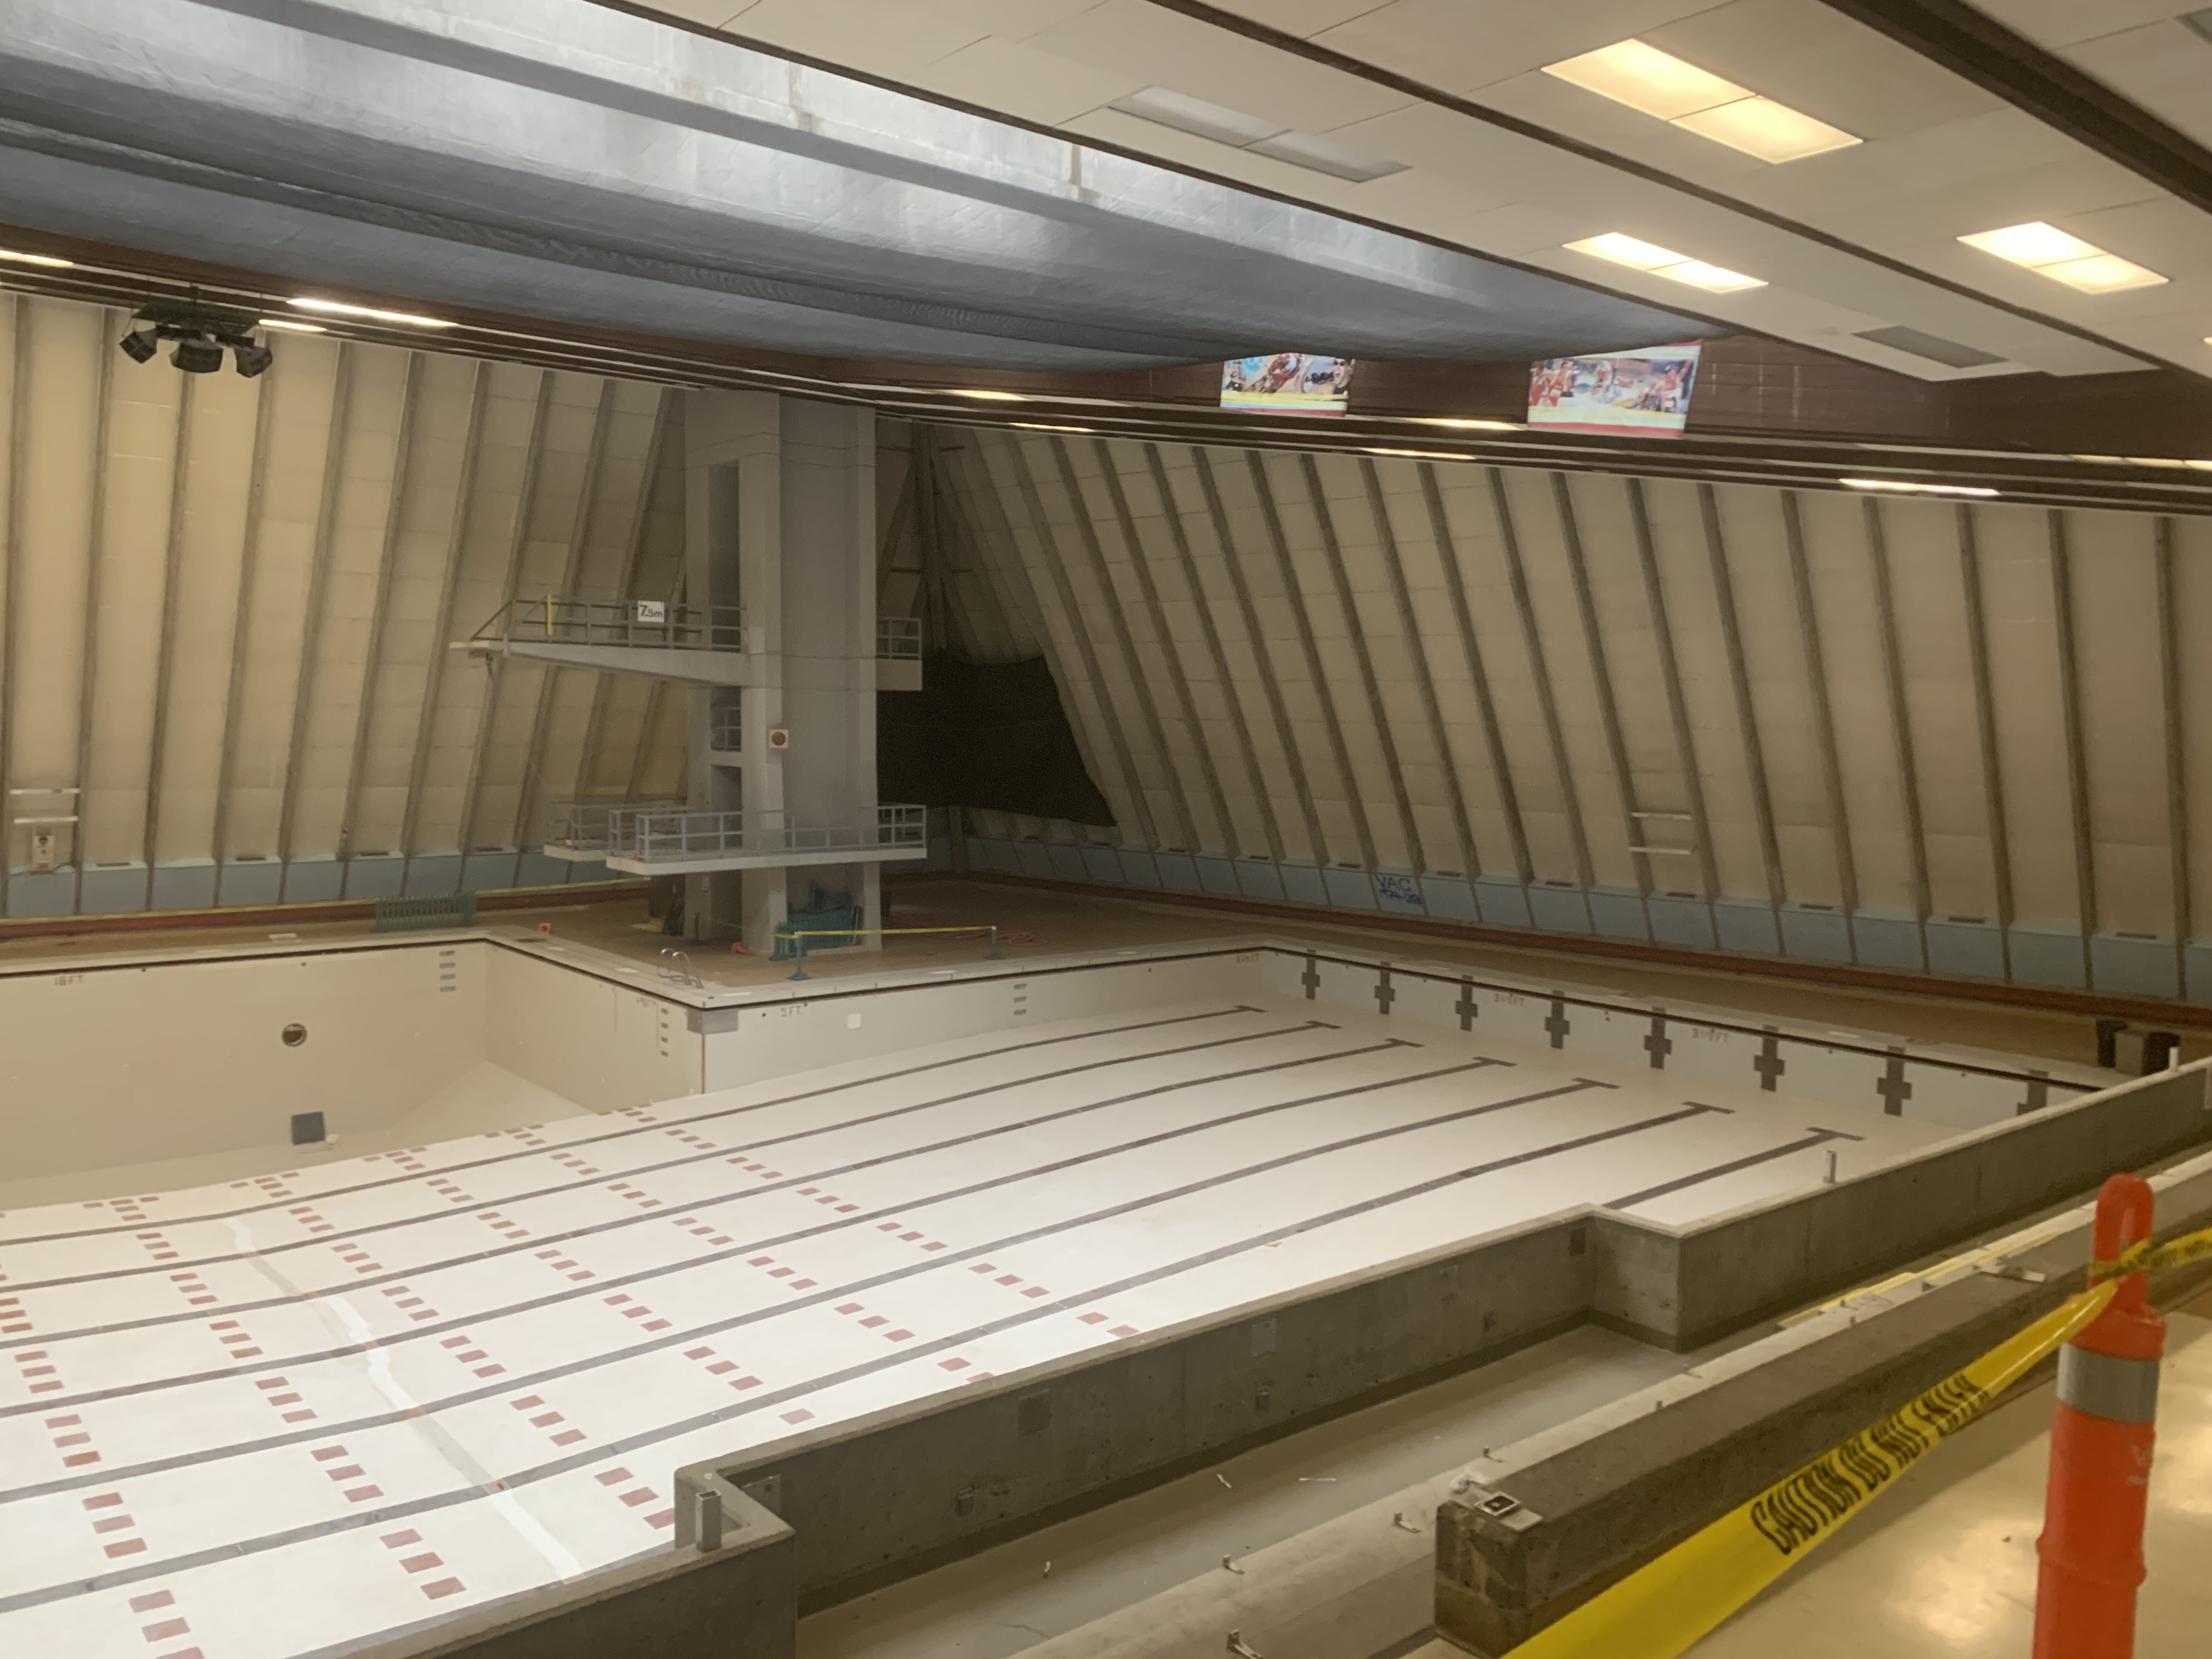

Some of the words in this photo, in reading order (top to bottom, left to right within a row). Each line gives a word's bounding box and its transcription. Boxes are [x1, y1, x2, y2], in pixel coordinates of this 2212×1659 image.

[640, 605, 663, 617] 7.5m
[1751, 1456, 1861, 1555] CAUTION
[1838, 1435, 1891, 1491] DO
[1870, 1414, 1929, 1469] NOT
